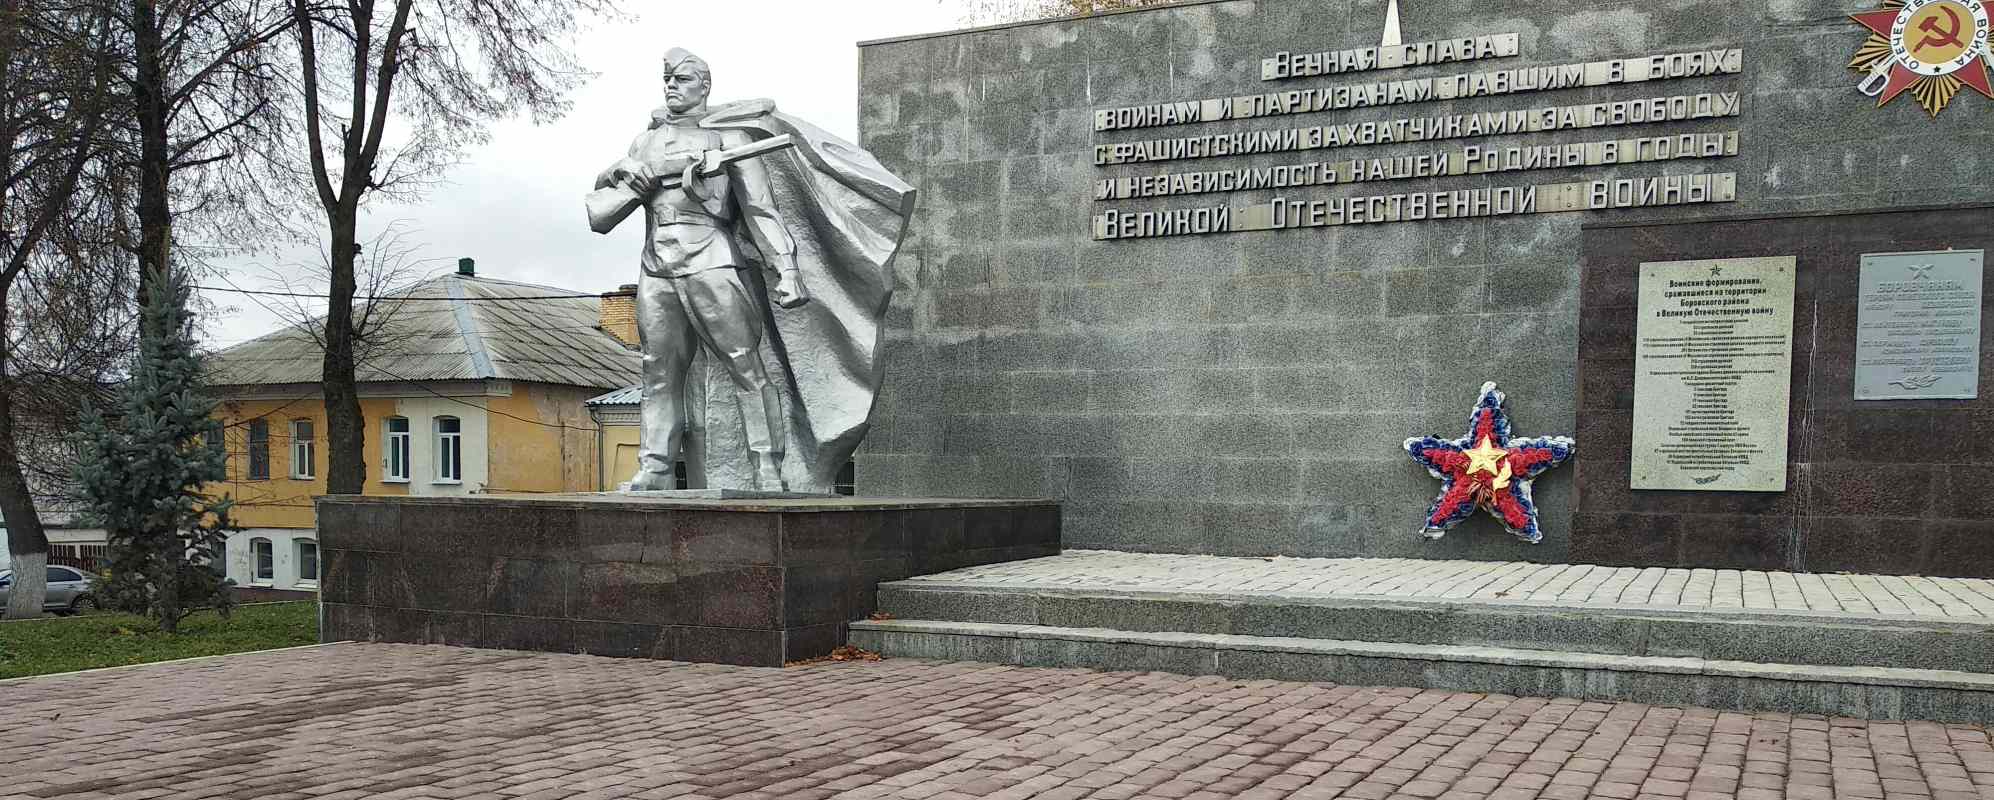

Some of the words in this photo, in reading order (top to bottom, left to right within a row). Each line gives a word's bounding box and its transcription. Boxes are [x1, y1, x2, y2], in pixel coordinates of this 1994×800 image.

[1276, 48, 1378, 77] ВЕЧНАЯ
[1402, 36, 1497, 65] СЛАВА
[1105, 101, 1200, 129] ВОИНАМ
[1217, 99, 1232, 118] И
[1455, 63, 1585, 98] ПАВШИМ
[1609, 59, 1625, 82] В
[1649, 49, 1729, 79] БОЯХ
[1095, 144, 1106, 165] С
[1115, 129, 1298, 162] ФАШИСТСКИМИ
[1309, 110, 1527, 148] ЗАХВАТЧИКАМИ
[1541, 106, 1577, 130] ЗА
[1592, 93, 1740, 125] СВОБОДУ
[1103, 178, 1116, 199] И
[1129, 162, 1336, 197] НЕЗАВИСИМОСТЬ
[1351, 150, 1448, 181] НАШЕЙ
[1603, 140, 1618, 163] В
[1637, 133, 1724, 161] ГОДЫ
[1105, 204, 1229, 239] ВЕЛИКОЙ
[1664, 289, 1713, 299] сражавшиеся
[1725, 288, 1767, 297] территории
[1669, 280, 1704, 288] Воинские
[1661, 309, 1693, 318] Великую
[1694, 308, 1751, 317] Отечественную
[1751, 306, 1774, 316] войну
[1680, 299, 1721, 308] Боровского
[1722, 298, 1750, 307] района
